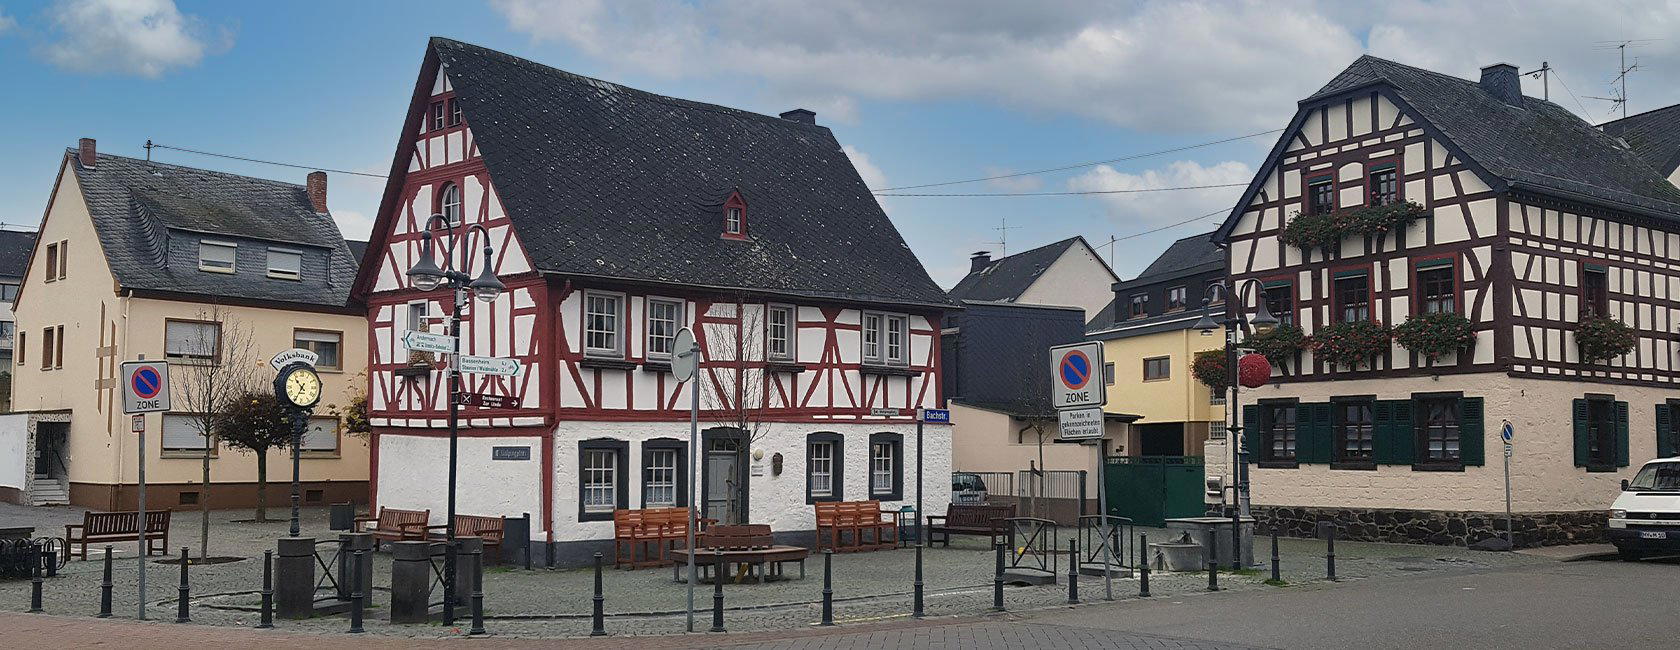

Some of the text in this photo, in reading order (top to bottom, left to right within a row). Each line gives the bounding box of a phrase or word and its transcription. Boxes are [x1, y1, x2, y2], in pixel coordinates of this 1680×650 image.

[275, 351, 315, 364] Volksbank
[1066, 392, 1090, 403] ZONE
[136, 400, 160, 410] ZONE
[926, 410, 948, 420] Bachstr.
